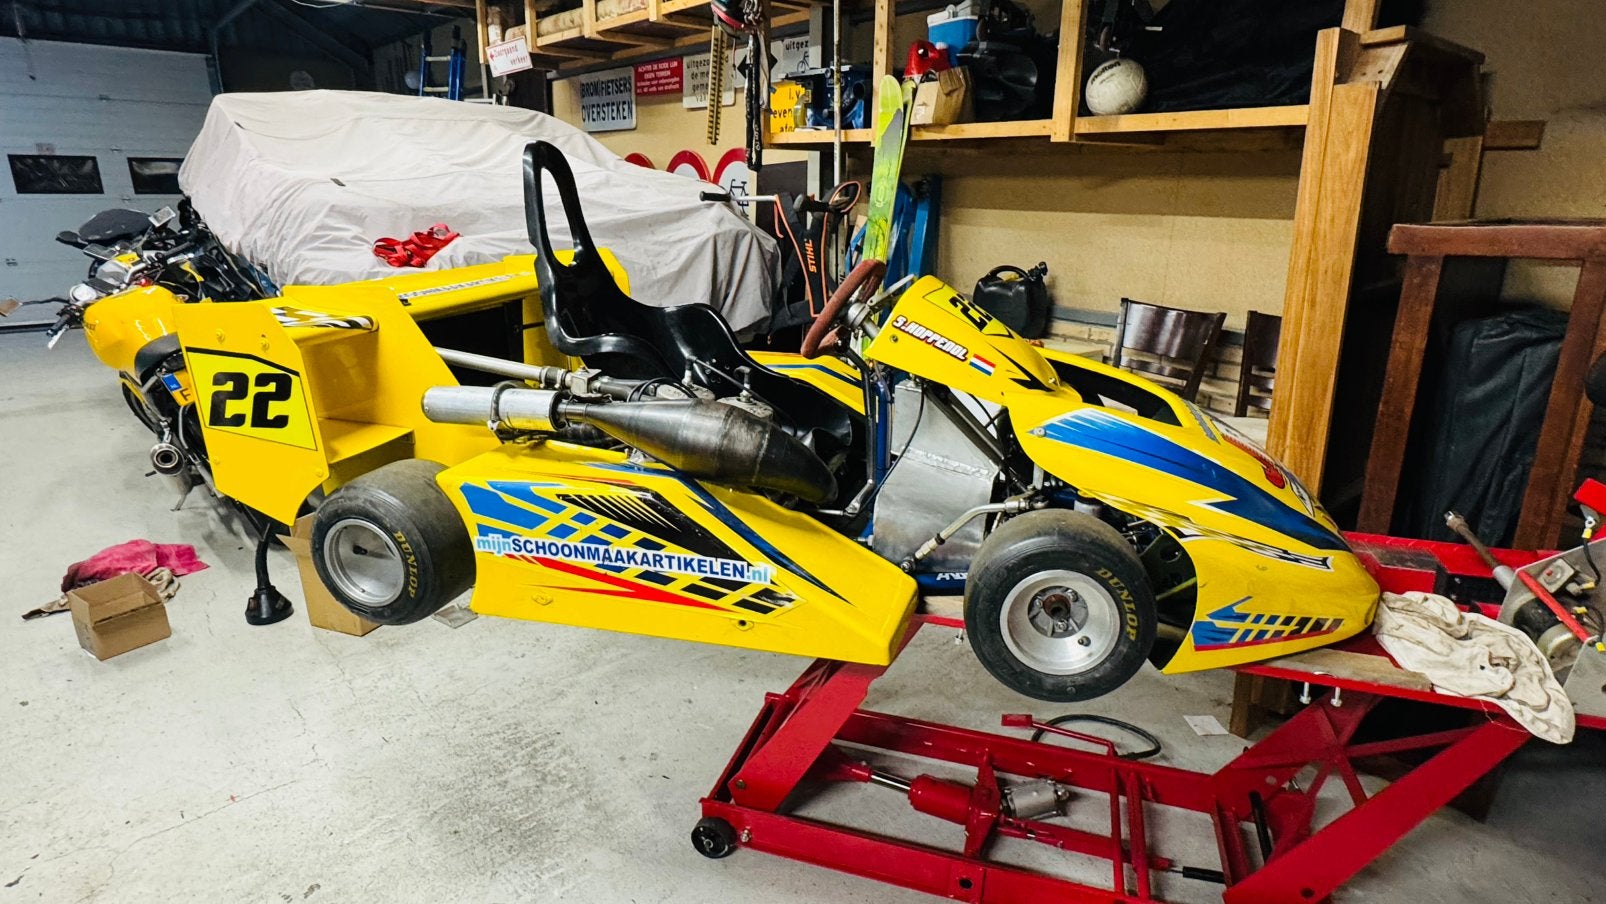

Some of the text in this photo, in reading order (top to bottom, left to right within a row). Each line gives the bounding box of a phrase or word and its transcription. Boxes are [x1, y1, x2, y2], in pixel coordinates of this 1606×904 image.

[581, 100, 633, 123] OVERSTEKEN
[805, 239, 817, 273] STIHL
[209, 371, 293, 429] 22
[394, 531, 418, 598] DUNLOP
[1096, 567, 1139, 641] DUNLOP
